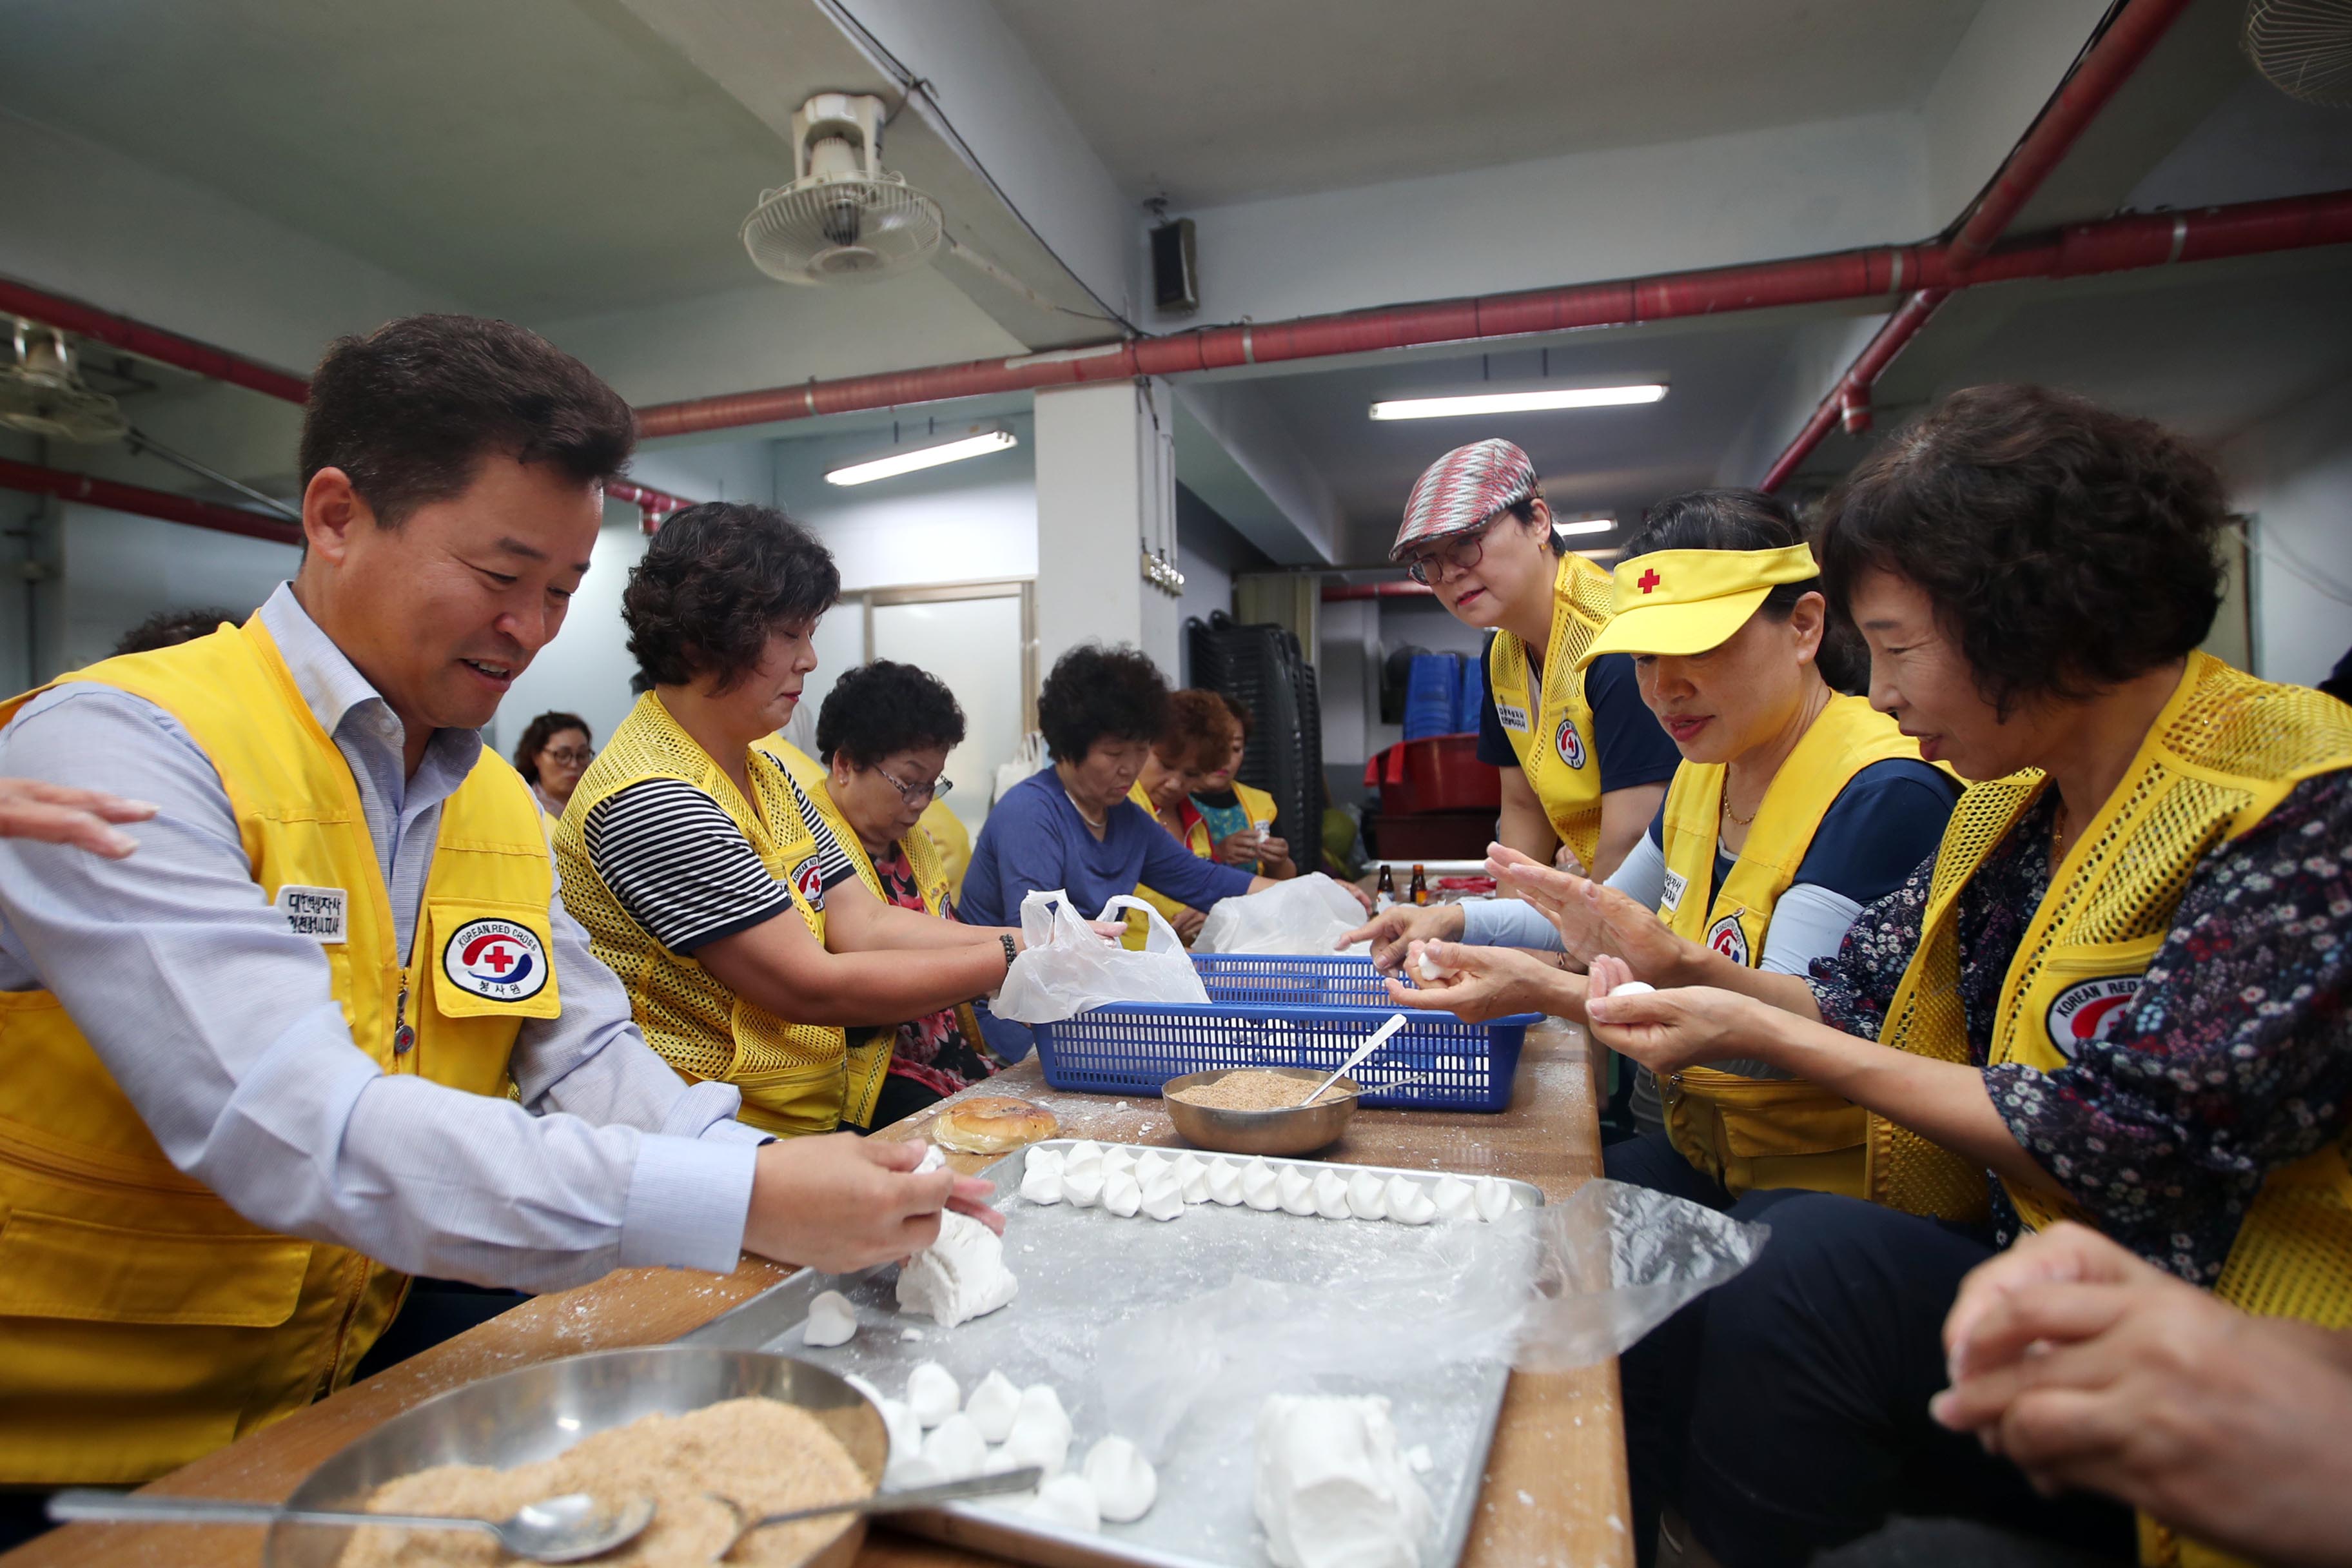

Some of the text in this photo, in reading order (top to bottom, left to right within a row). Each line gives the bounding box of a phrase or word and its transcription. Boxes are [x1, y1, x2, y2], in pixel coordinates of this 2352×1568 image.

[457, 924, 537, 952] KOREAN RED CROSS
[2055, 981, 2139, 1018] KOREAN RED
